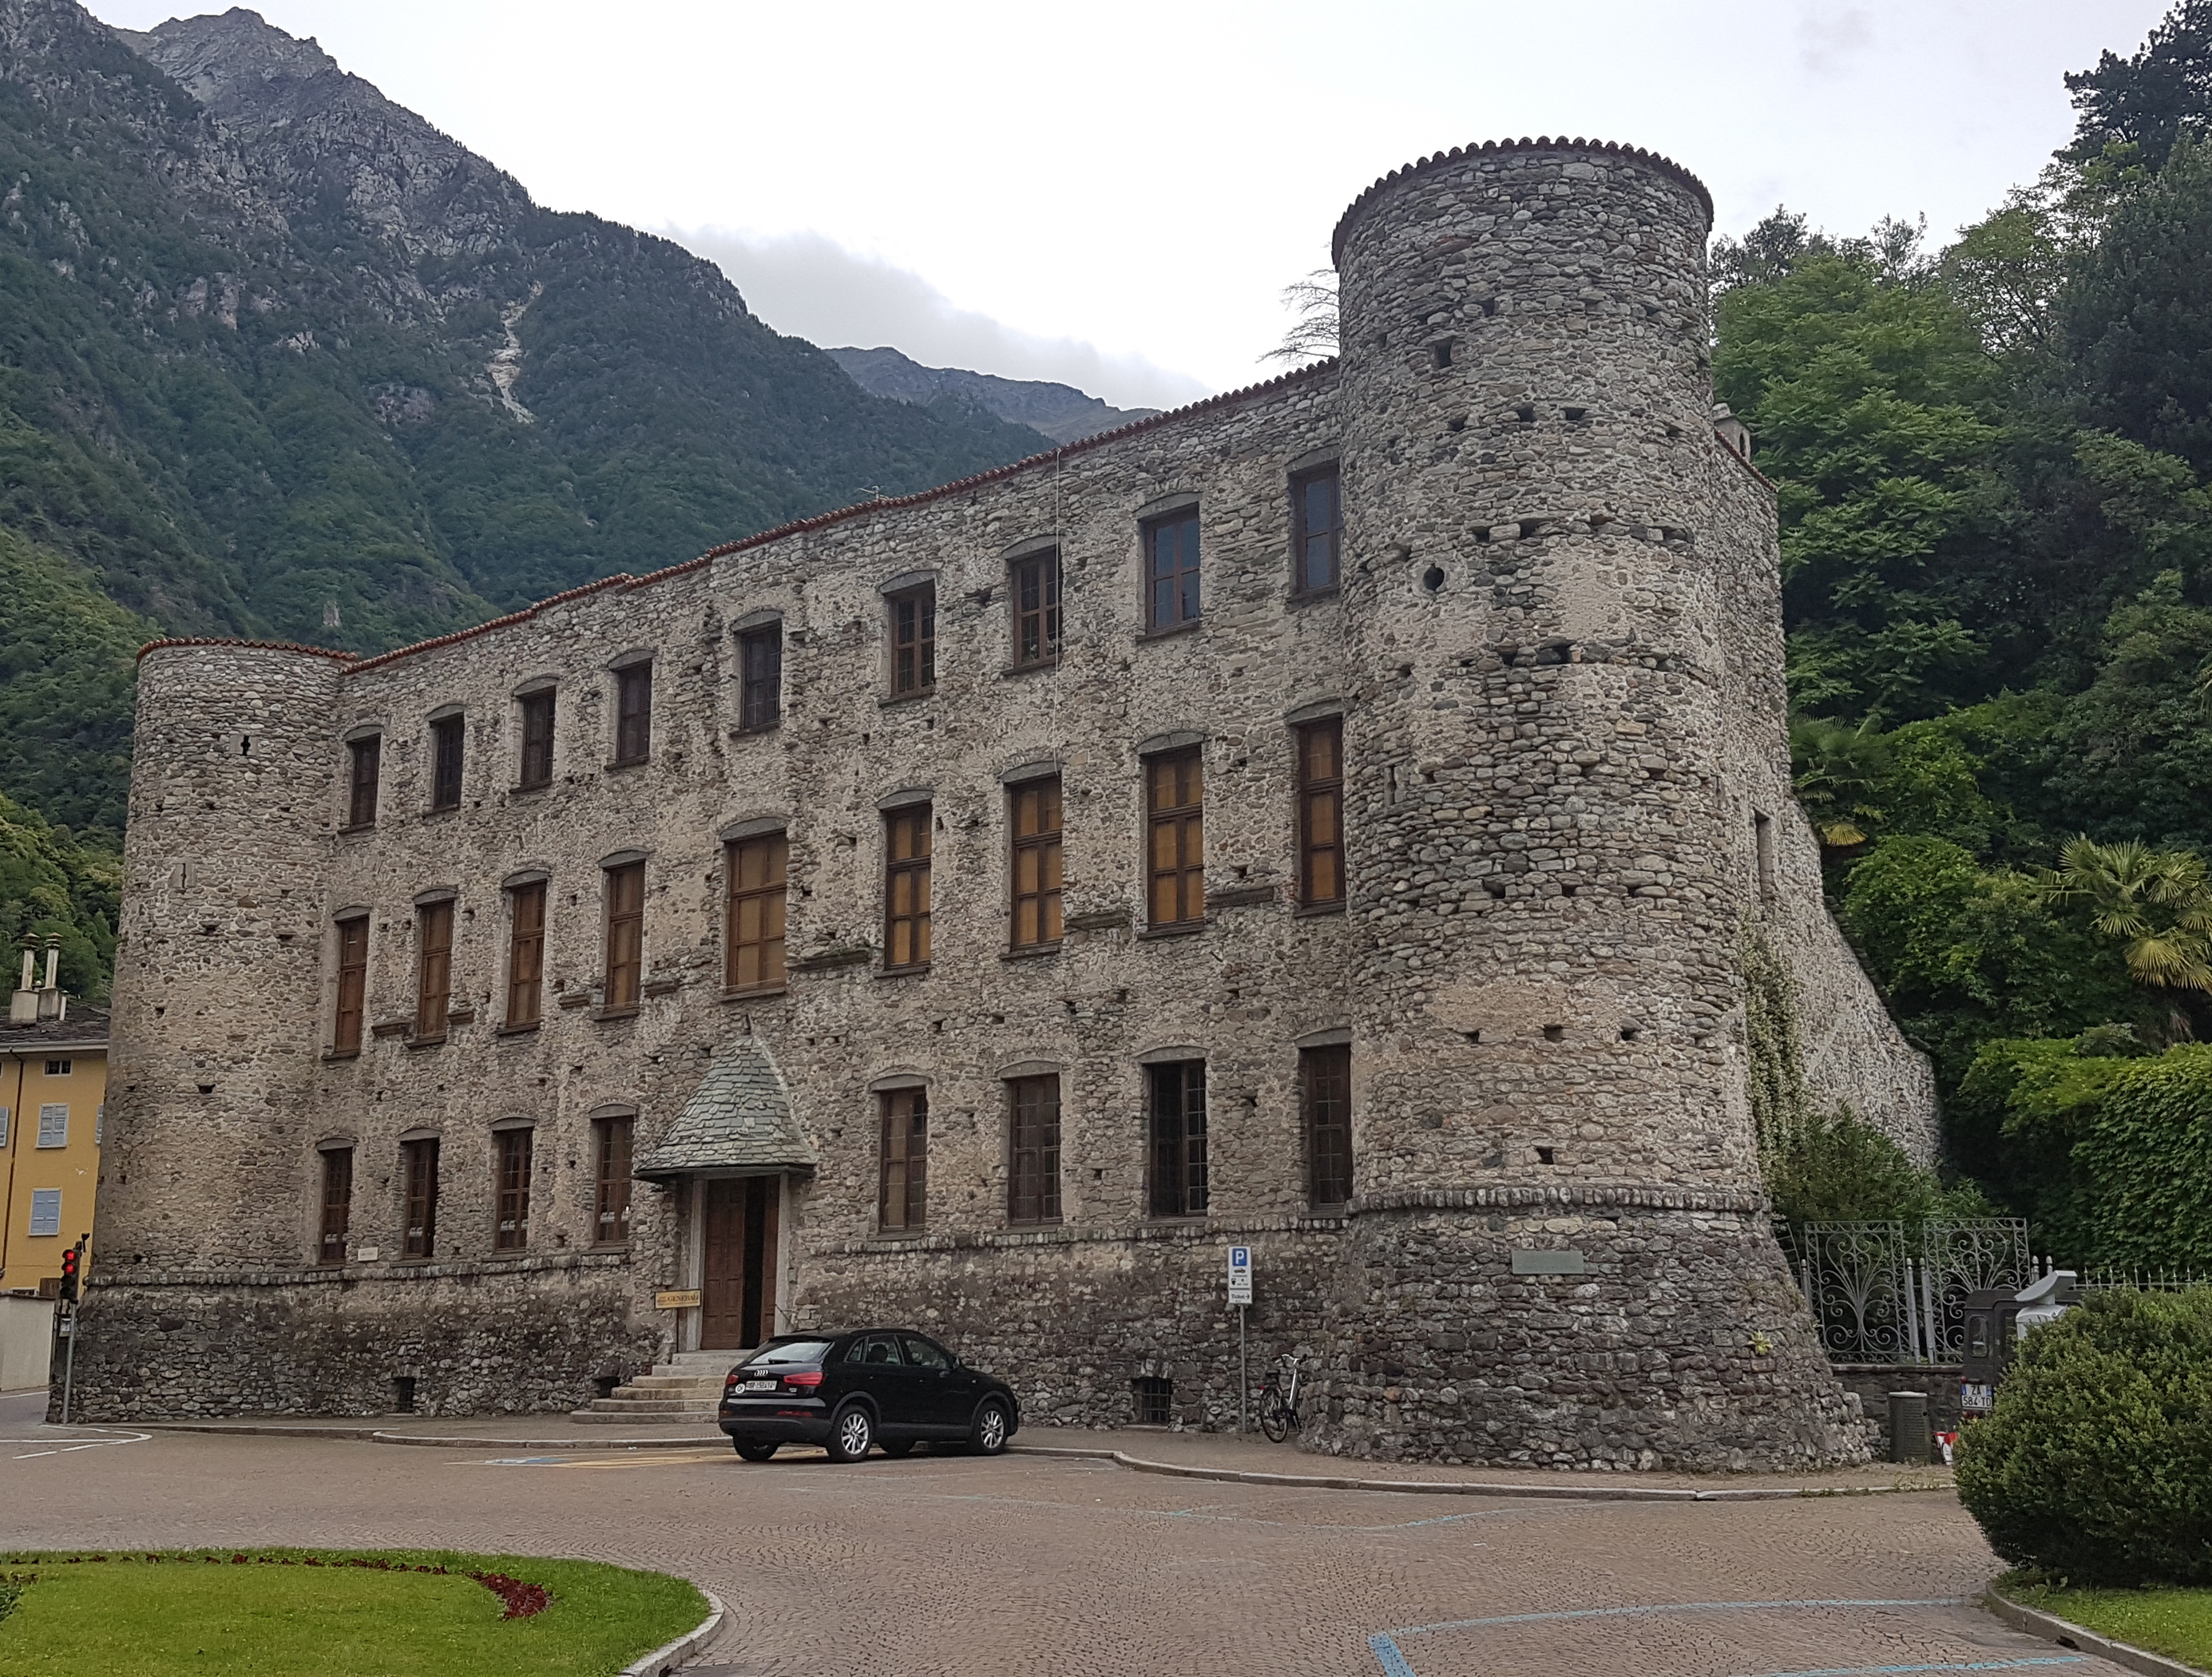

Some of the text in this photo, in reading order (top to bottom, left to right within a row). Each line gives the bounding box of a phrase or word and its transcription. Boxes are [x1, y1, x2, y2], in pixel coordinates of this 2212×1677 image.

[1235, 1250, 1244, 1264] P
[668, 1291, 699, 1302] GENERALI
[1971, 1386, 1981, 1395] ZA
[1963, 1397, 1978, 1405] 584
